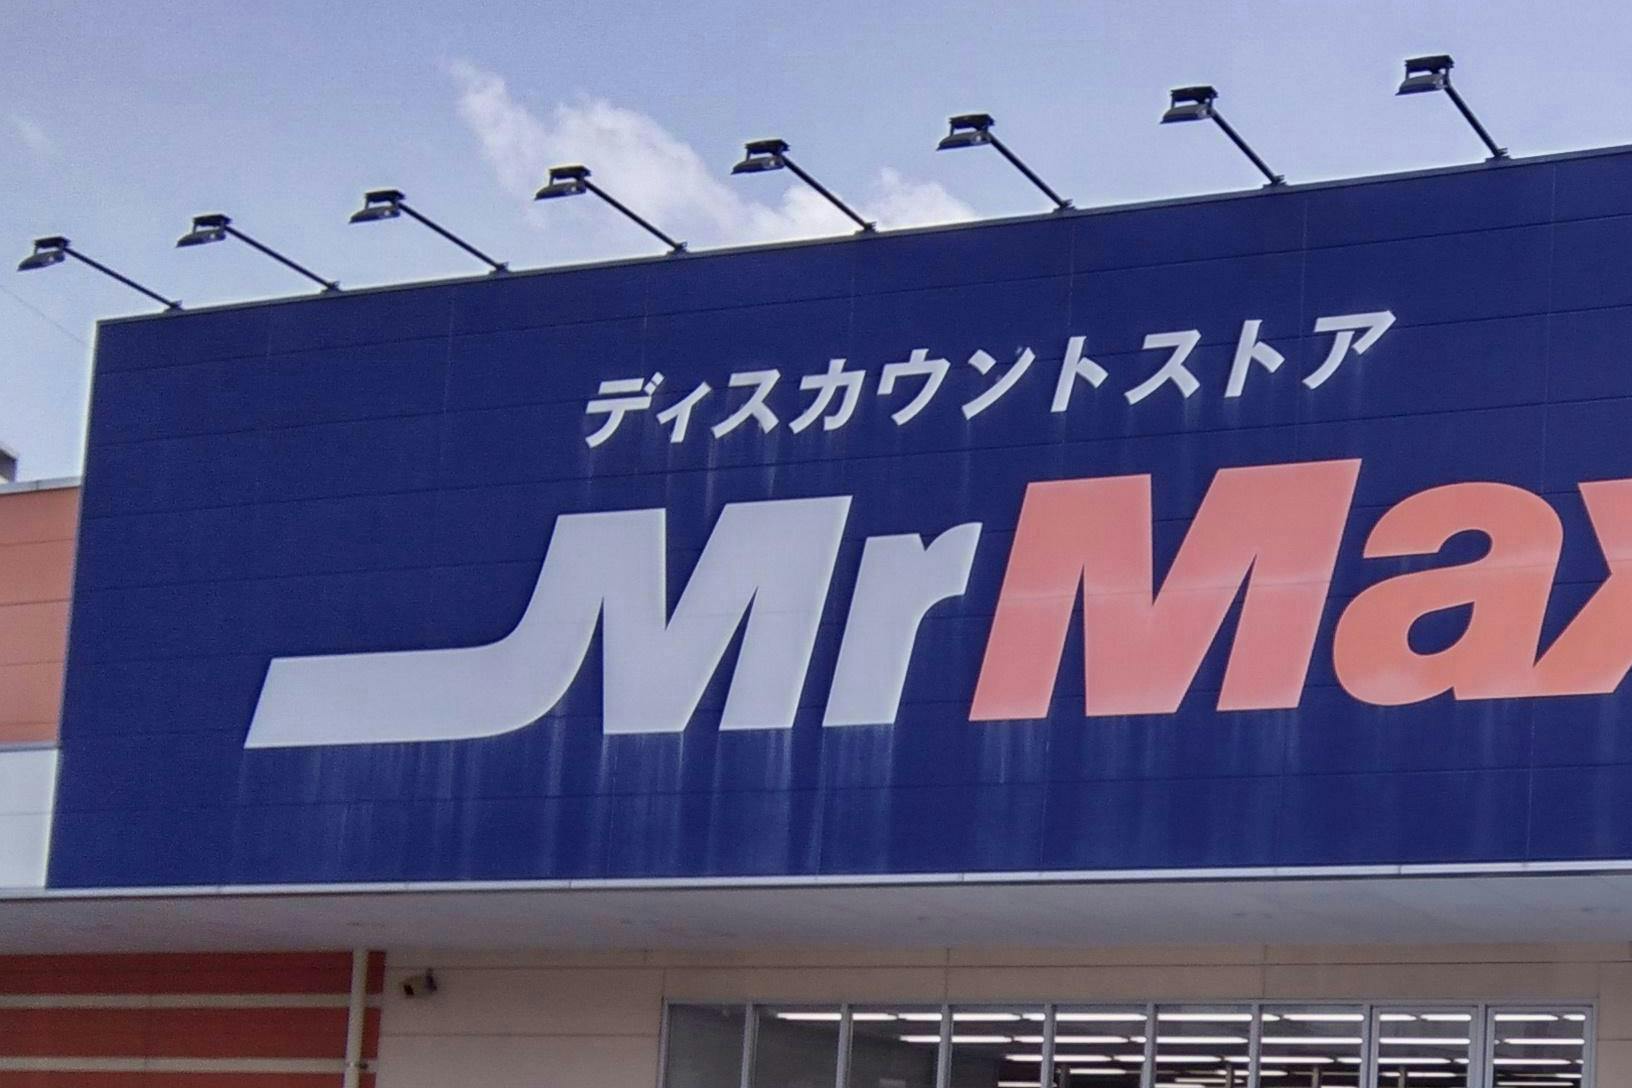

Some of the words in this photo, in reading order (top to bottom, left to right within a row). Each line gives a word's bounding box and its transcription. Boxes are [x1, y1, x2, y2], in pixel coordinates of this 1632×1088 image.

[582, 308, 1396, 448] ディスカウントストア
